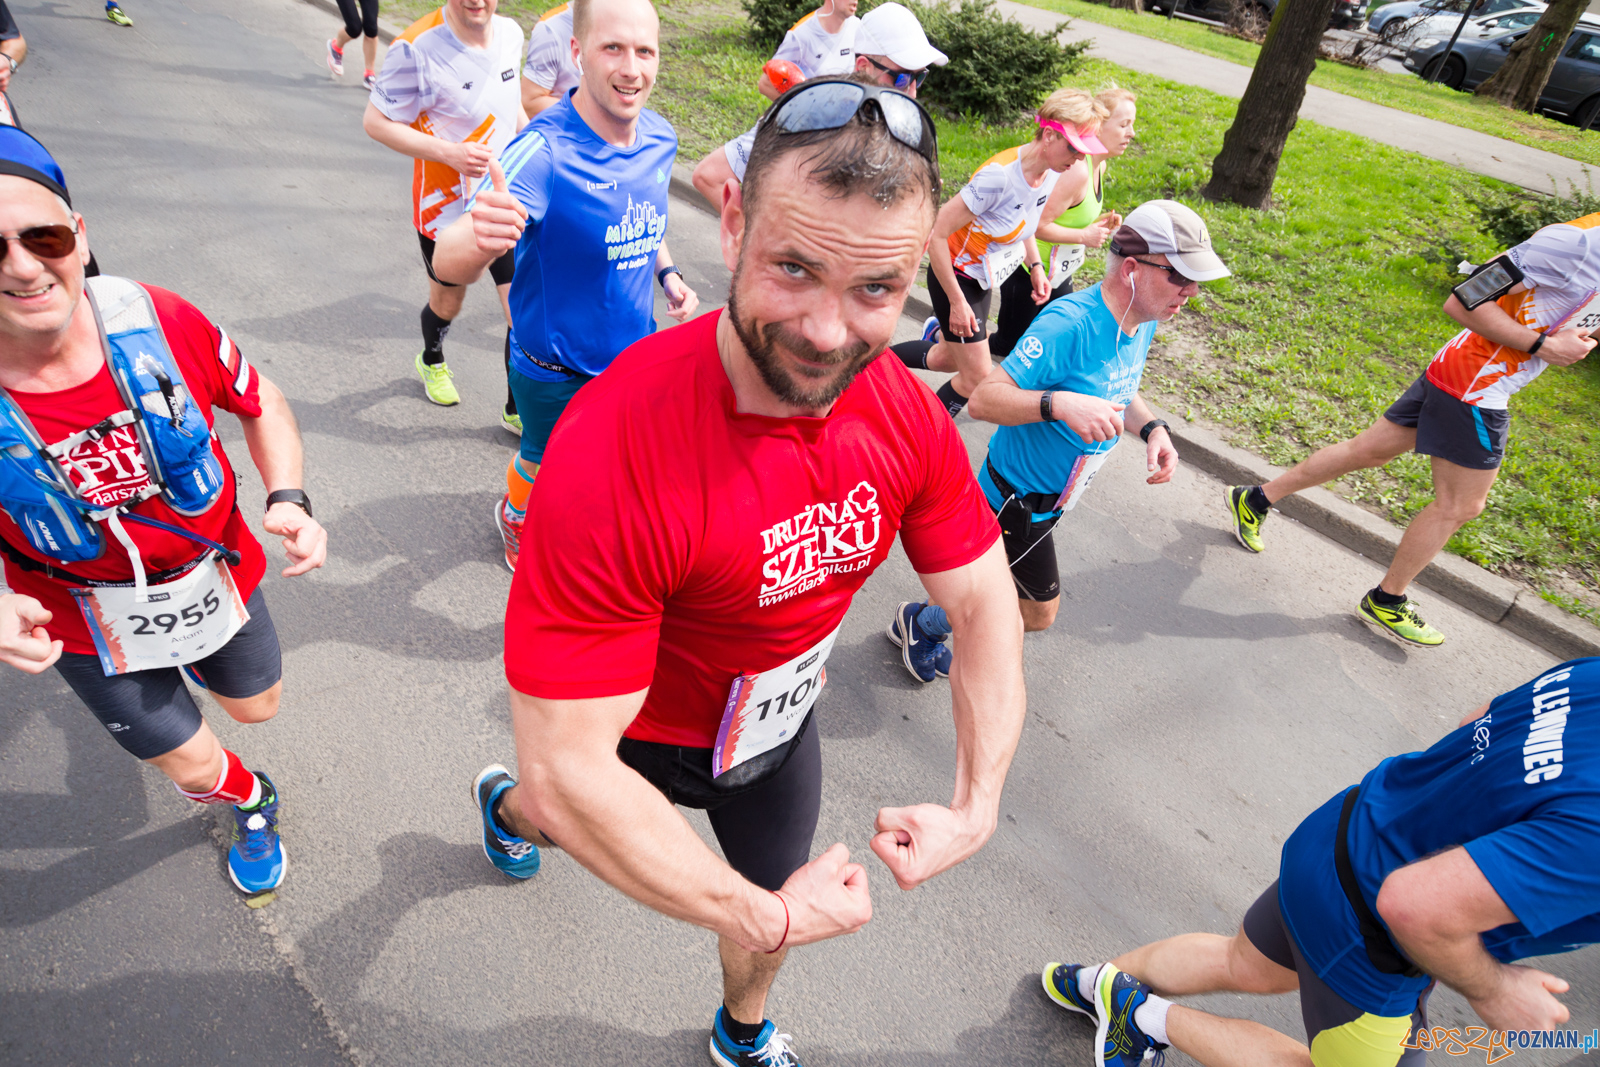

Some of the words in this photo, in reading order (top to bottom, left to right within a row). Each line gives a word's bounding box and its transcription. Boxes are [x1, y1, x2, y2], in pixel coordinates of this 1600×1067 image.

[604, 220, 645, 244] MIŁO
[1014, 347, 1033, 369] TOYOTA
[127, 588, 220, 636] 2955
[171, 629, 204, 644] Adam
